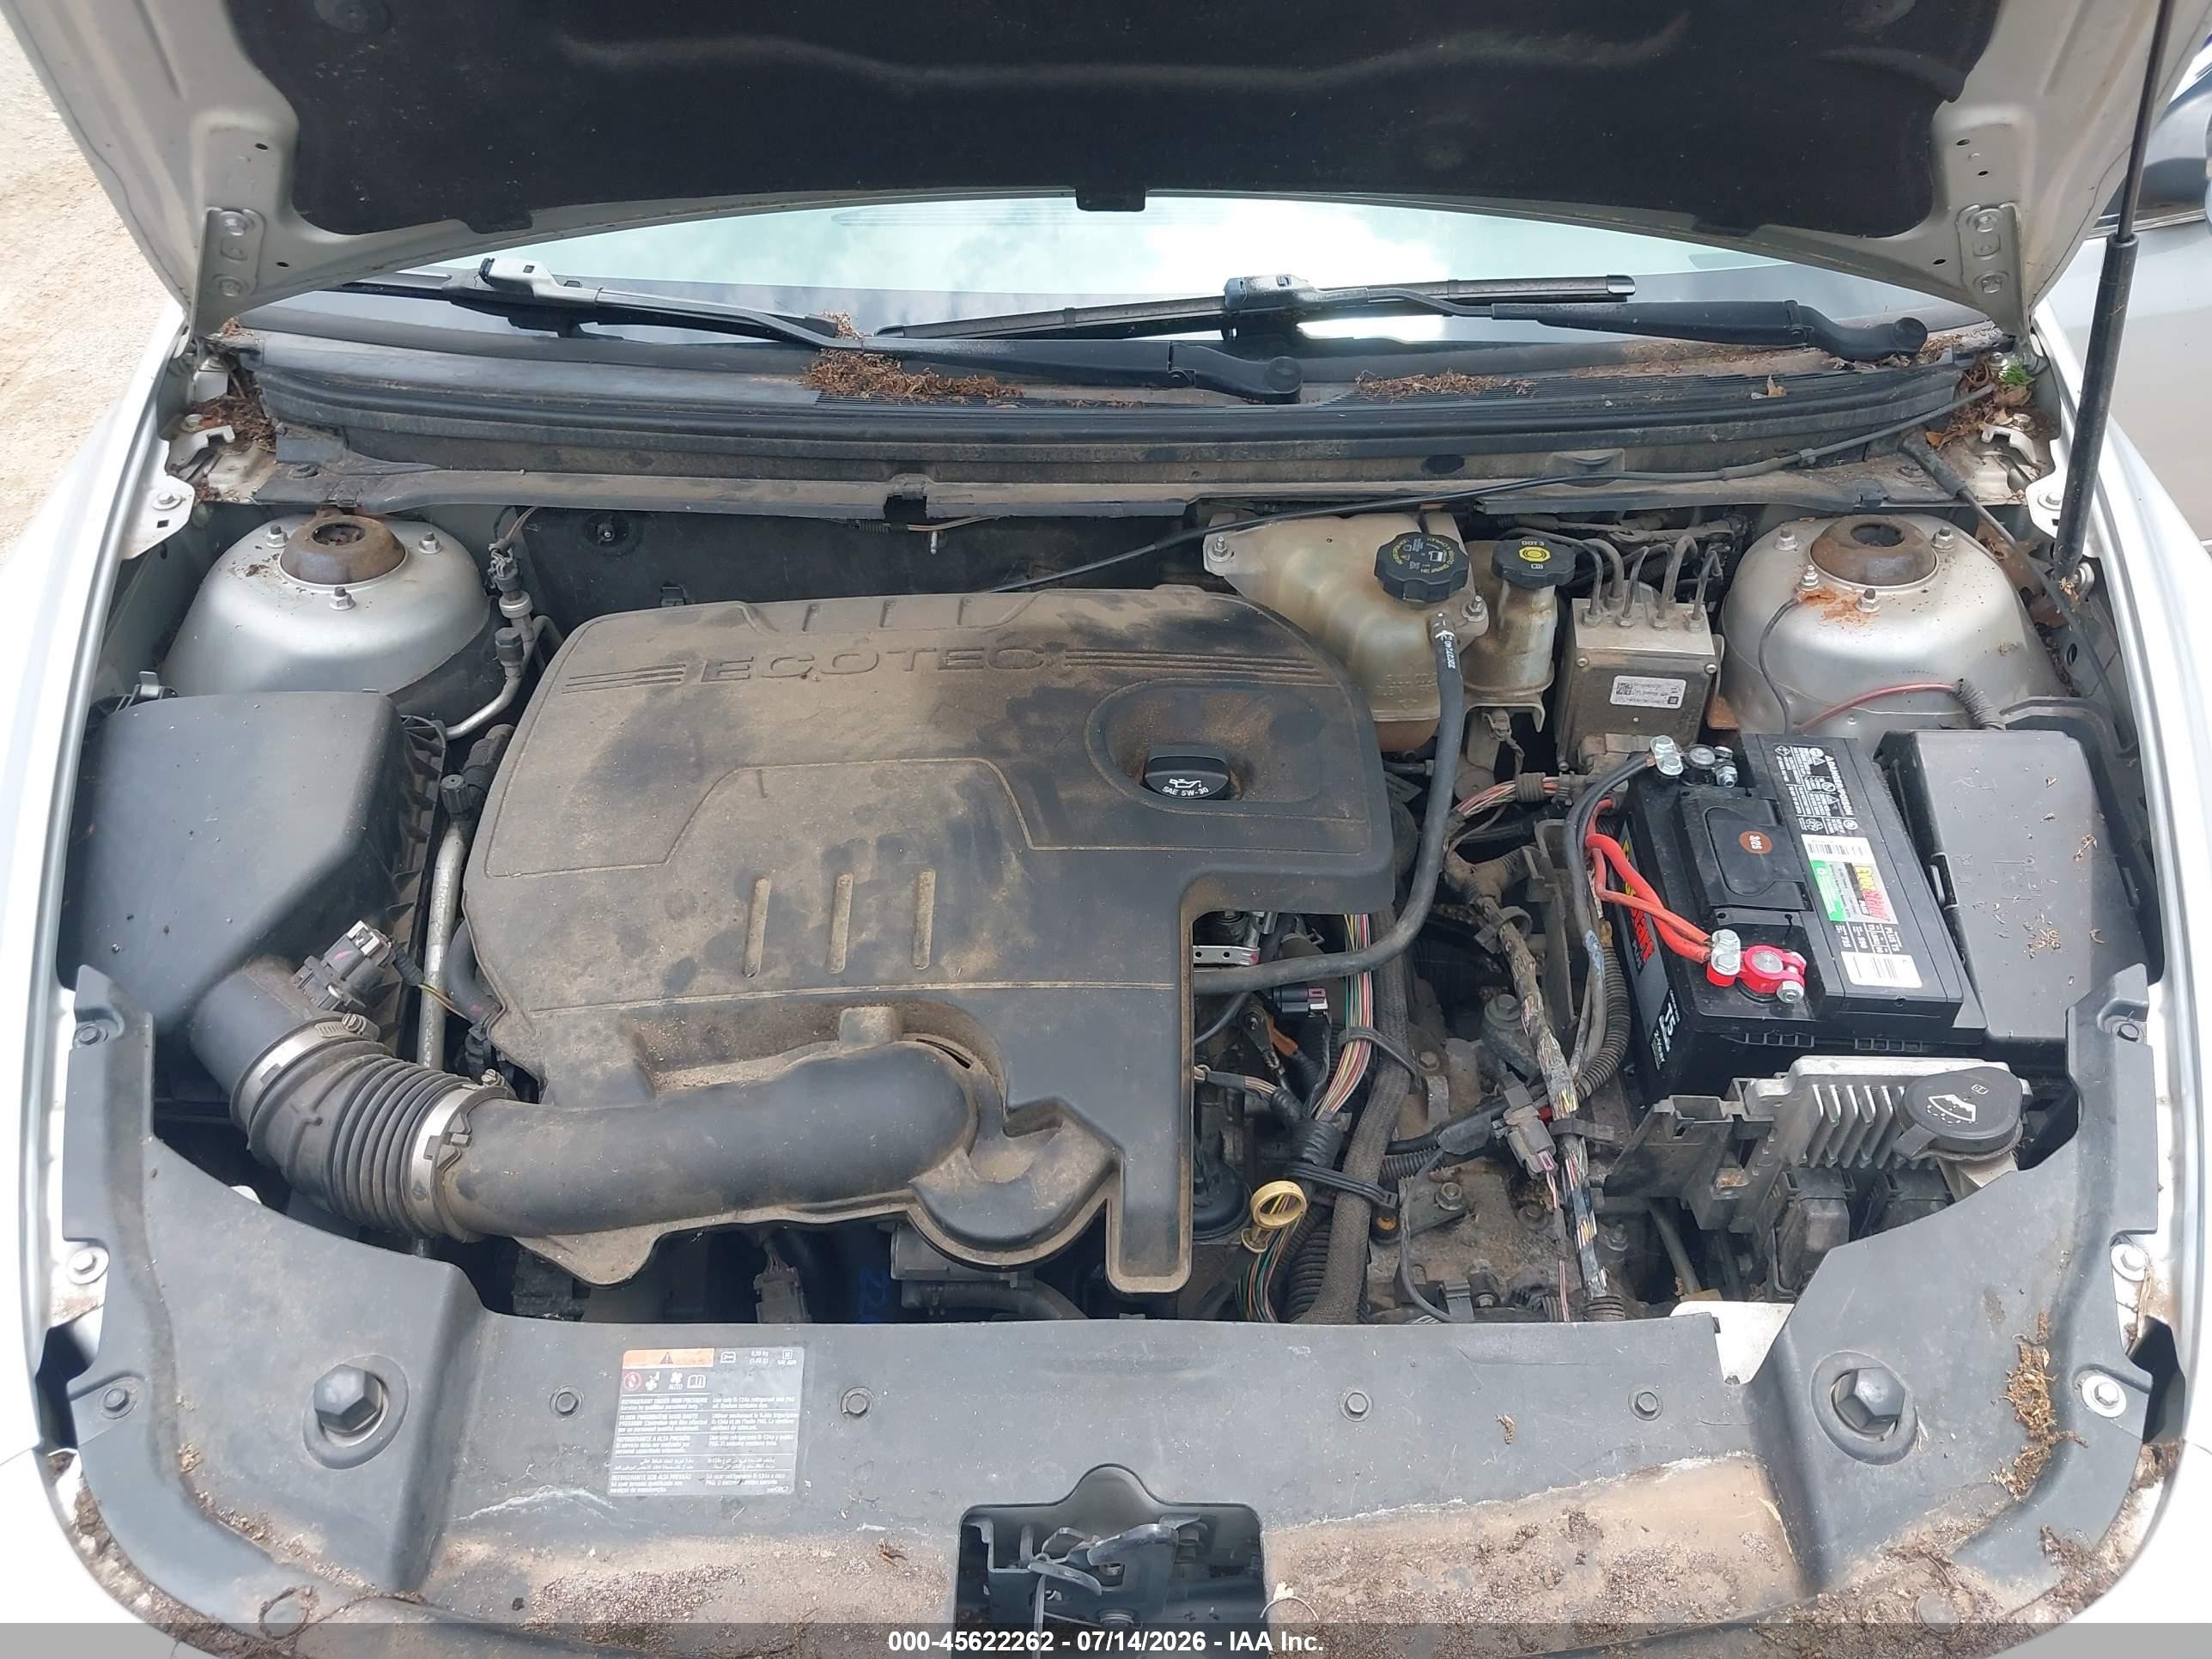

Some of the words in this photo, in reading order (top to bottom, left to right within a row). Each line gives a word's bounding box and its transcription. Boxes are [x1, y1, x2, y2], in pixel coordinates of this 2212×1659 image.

[699, 645, 1044, 684] ECOTEC
[1162, 786, 1179, 795] SAE
[1181, 787, 1209, 796] 5W-30
[1665, 1002, 1676, 1036] T5
